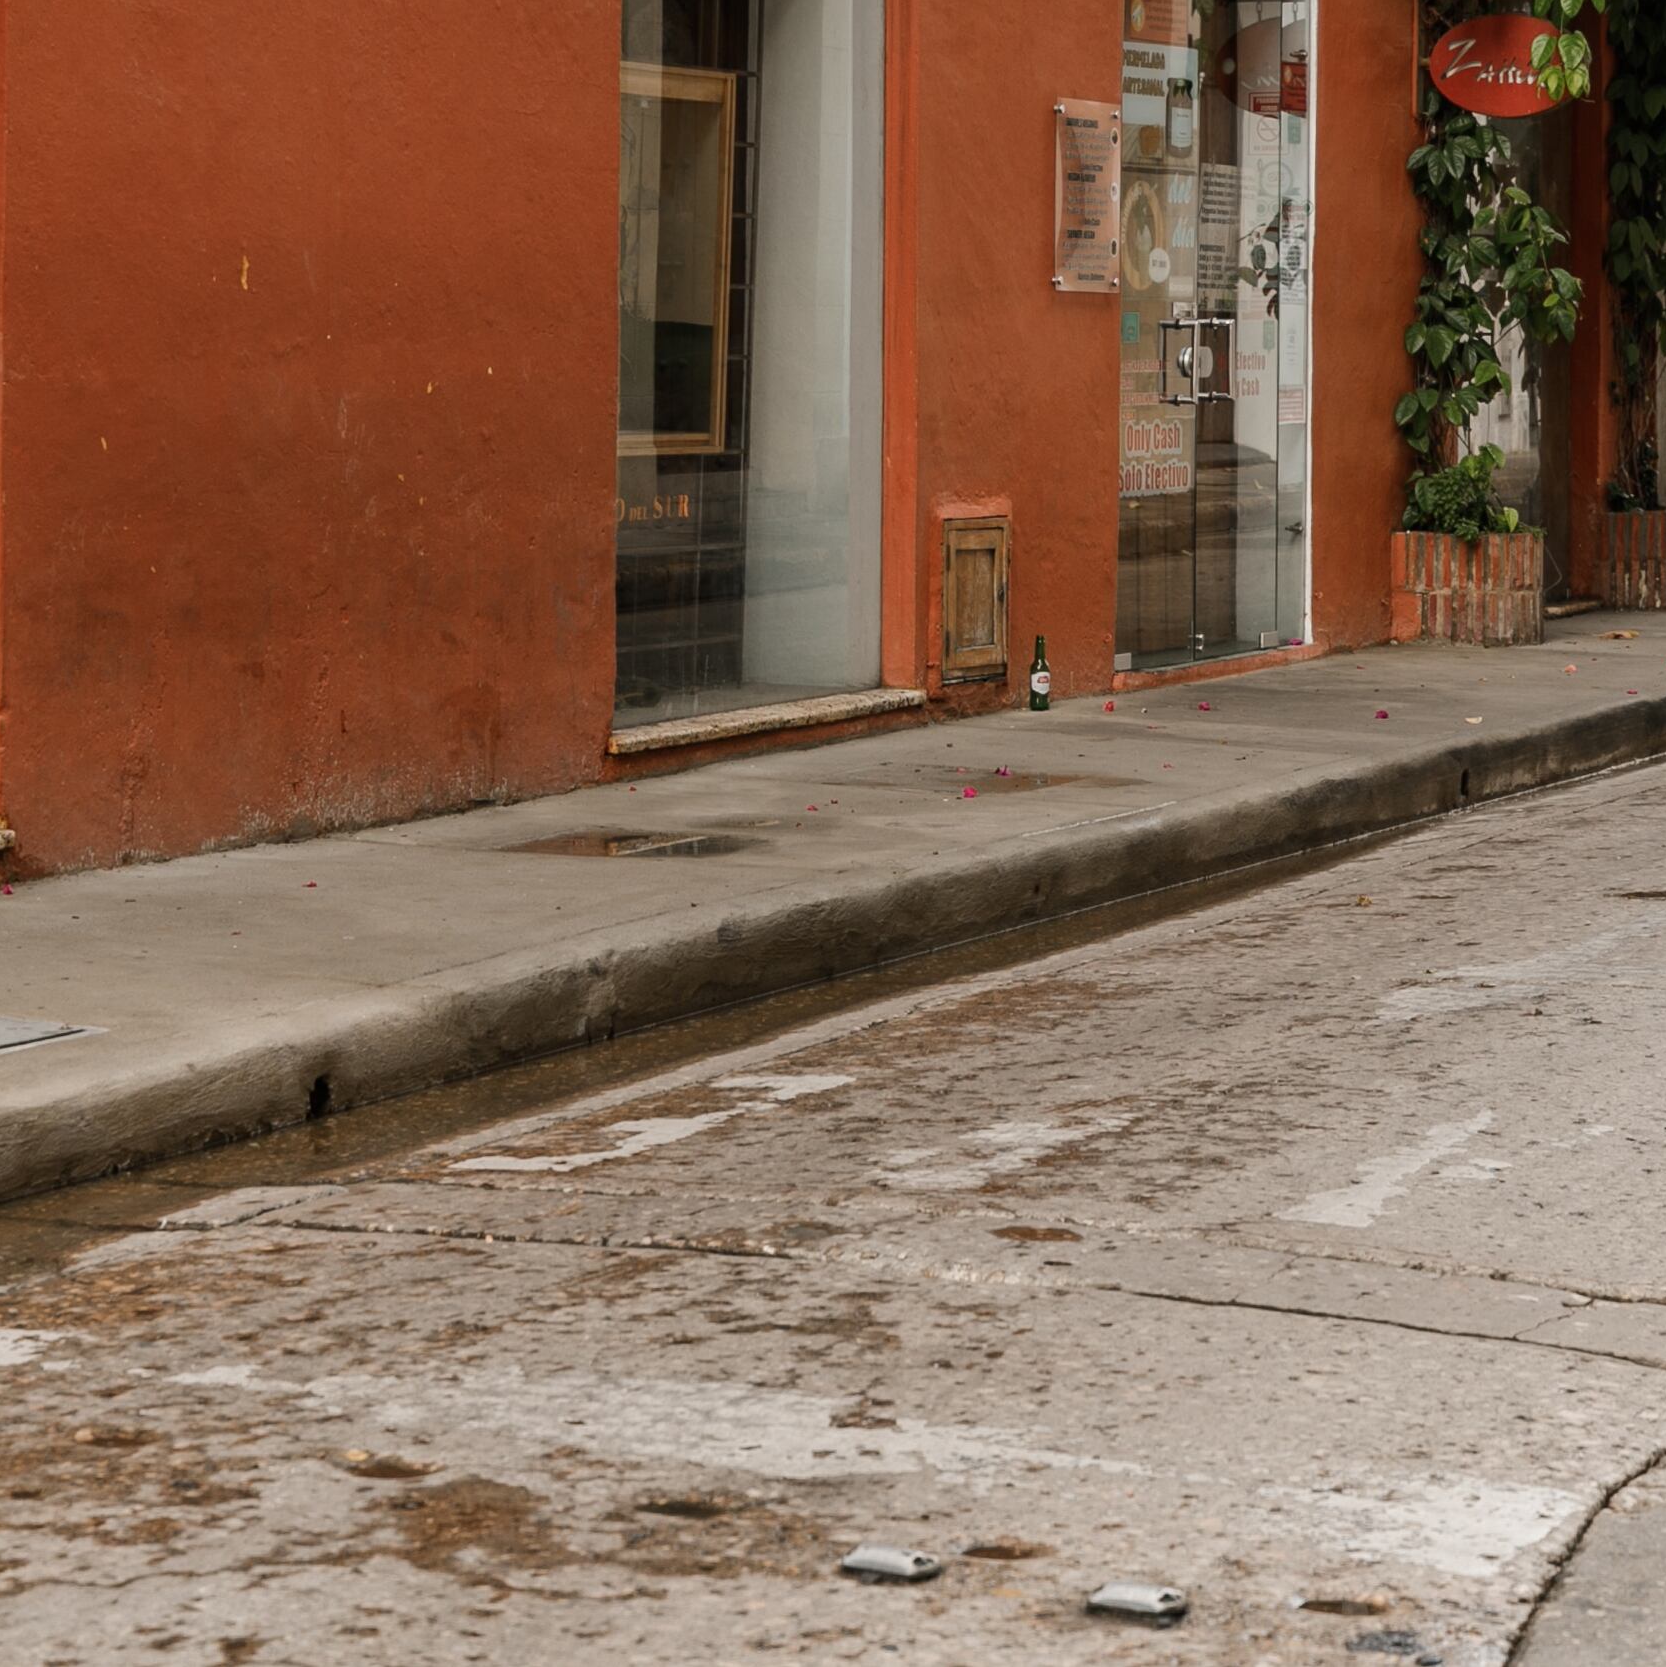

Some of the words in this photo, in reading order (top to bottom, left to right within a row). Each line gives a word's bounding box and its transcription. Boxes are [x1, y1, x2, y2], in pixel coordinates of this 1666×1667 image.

[1127, 423, 1151, 453] Only
[1153, 422, 1181, 450] Cash
[1119, 464, 1143, 492] Solo
[1145, 461, 1189, 490] Efectivo
